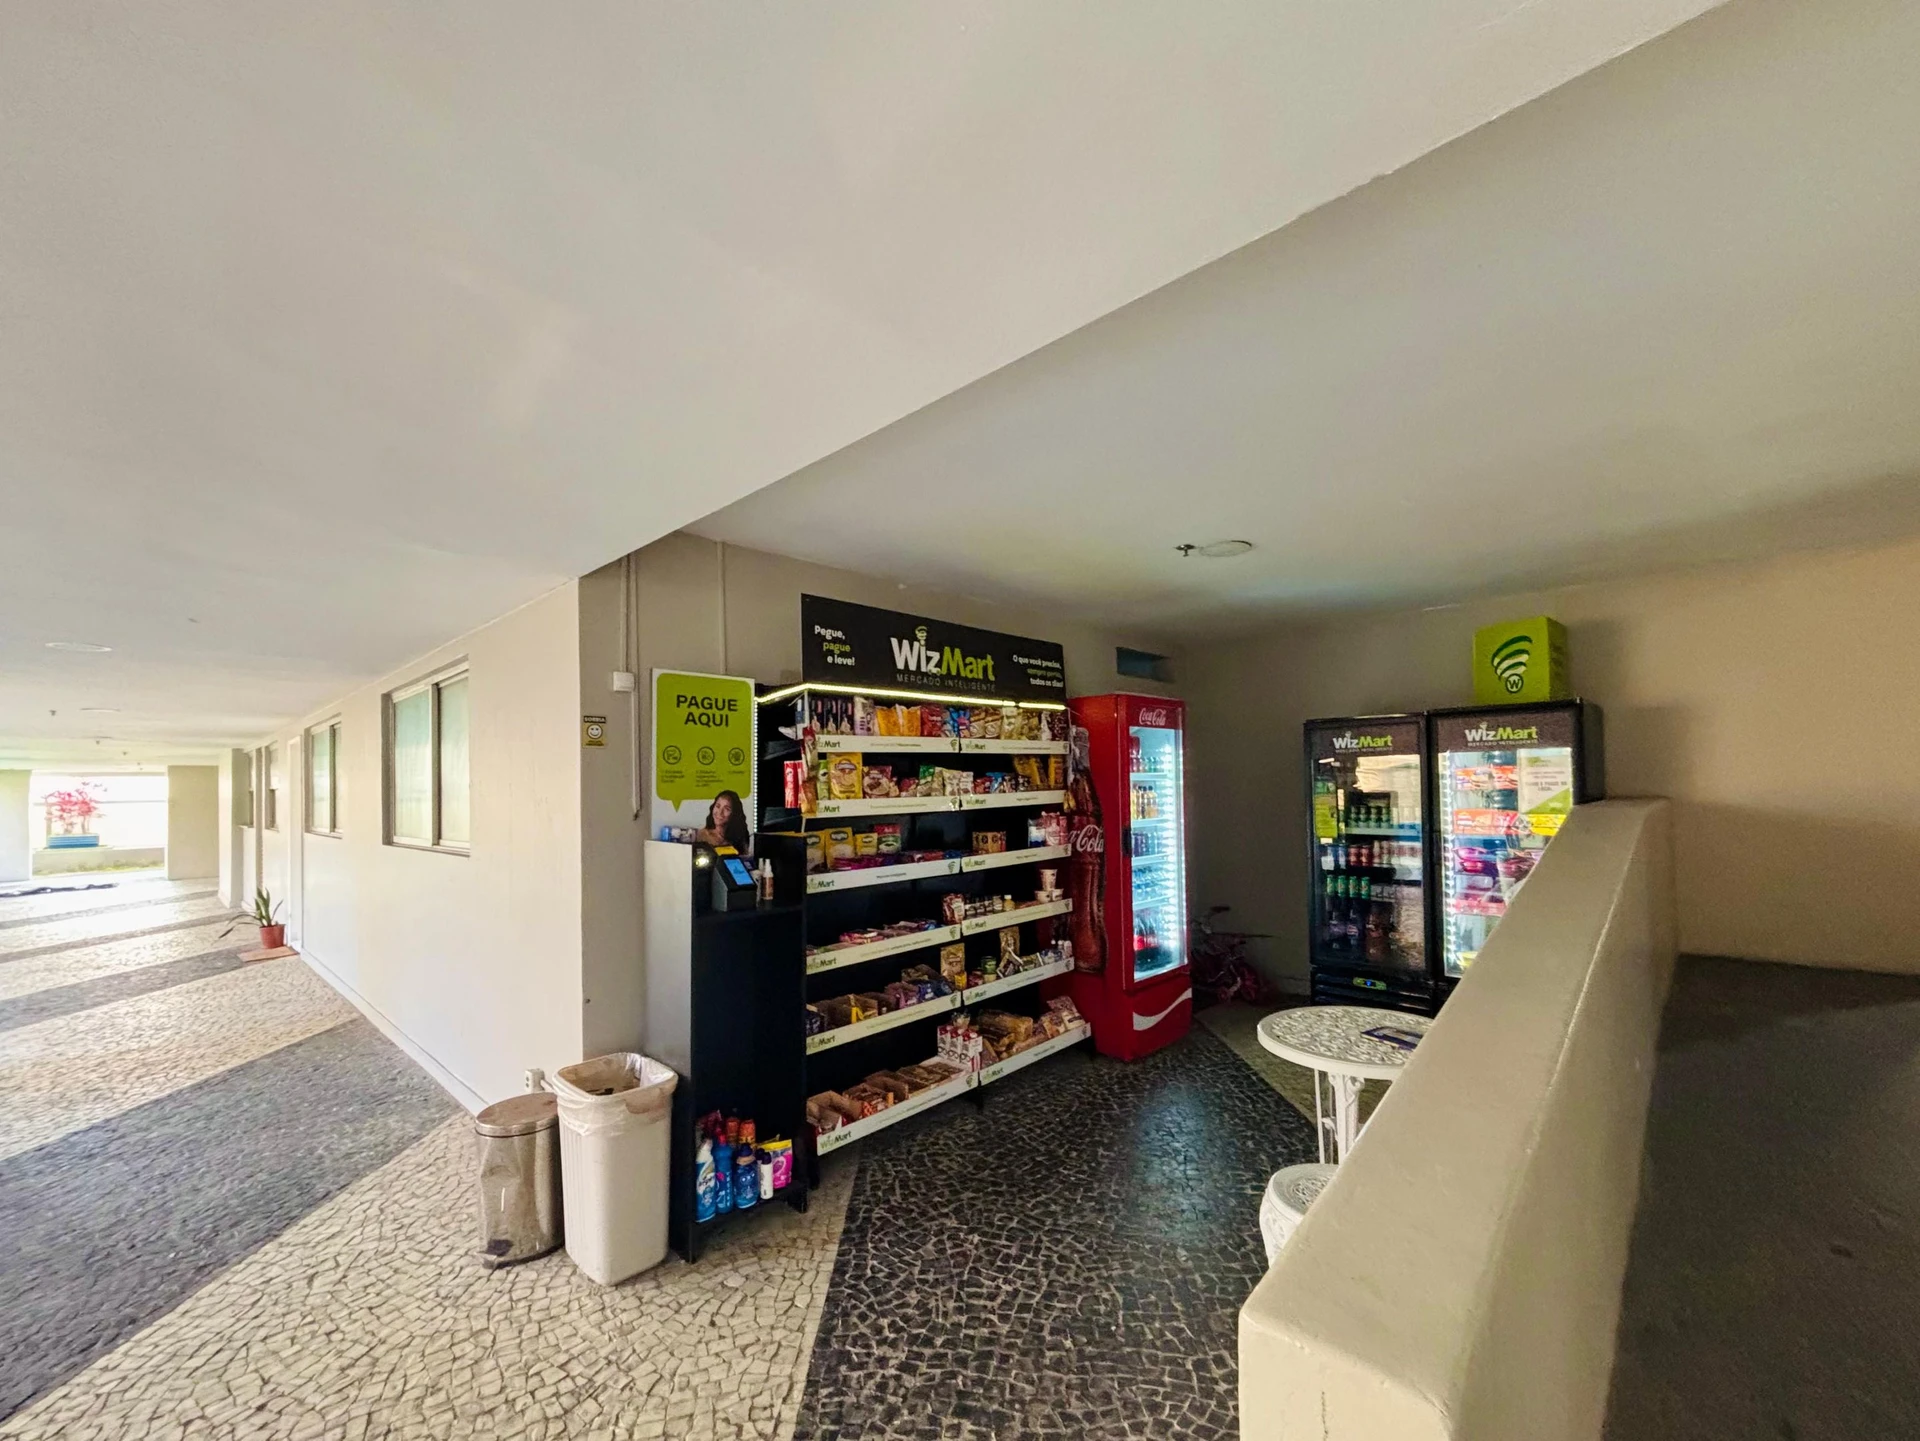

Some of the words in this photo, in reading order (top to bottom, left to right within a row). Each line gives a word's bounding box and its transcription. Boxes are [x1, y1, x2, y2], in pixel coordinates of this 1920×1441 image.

[814, 625, 845, 640] Pegue,
[822, 641, 851, 654] pague
[827, 656, 834, 664] e
[834, 655, 855, 666] leve!
[890, 637, 995, 681] WizMart
[896, 673, 941, 687] MERCADO
[944, 679, 996, 692] INTELIGENTE
[676, 694, 738, 712] PAGUE
[684, 712, 730, 728] AQUI
[1464, 726, 1538, 741] WizMart
[1332, 735, 1393, 749] WizMart
